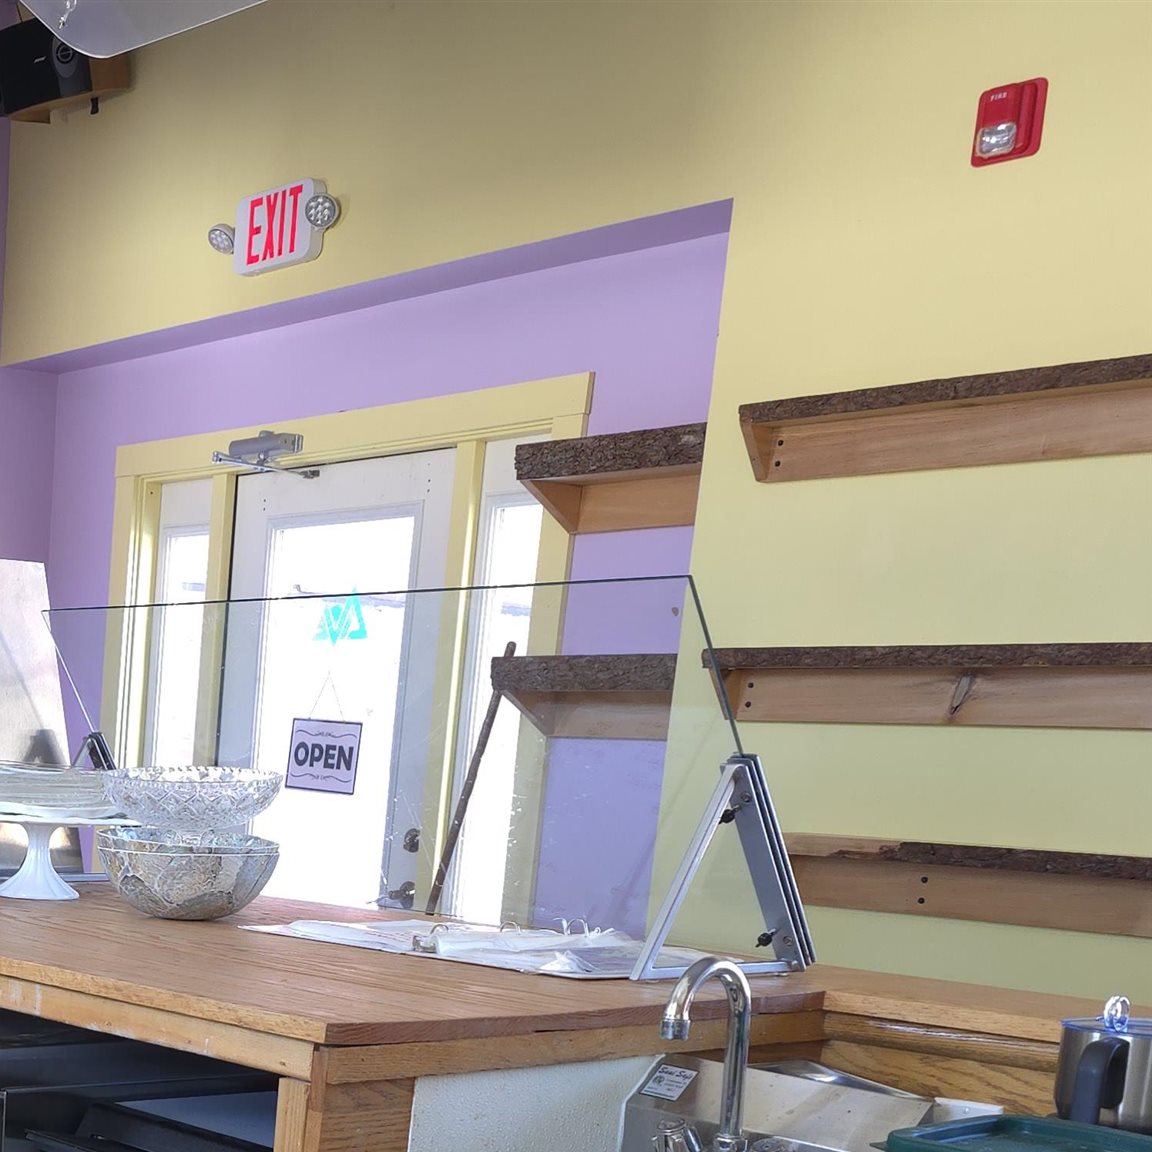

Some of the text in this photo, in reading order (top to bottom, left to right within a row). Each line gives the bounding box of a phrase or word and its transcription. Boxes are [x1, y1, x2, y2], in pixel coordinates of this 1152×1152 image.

[990, 92, 1008, 101] FIRE
[246, 184, 303, 265] EXIT
[294, 741, 354, 771] OPEN
